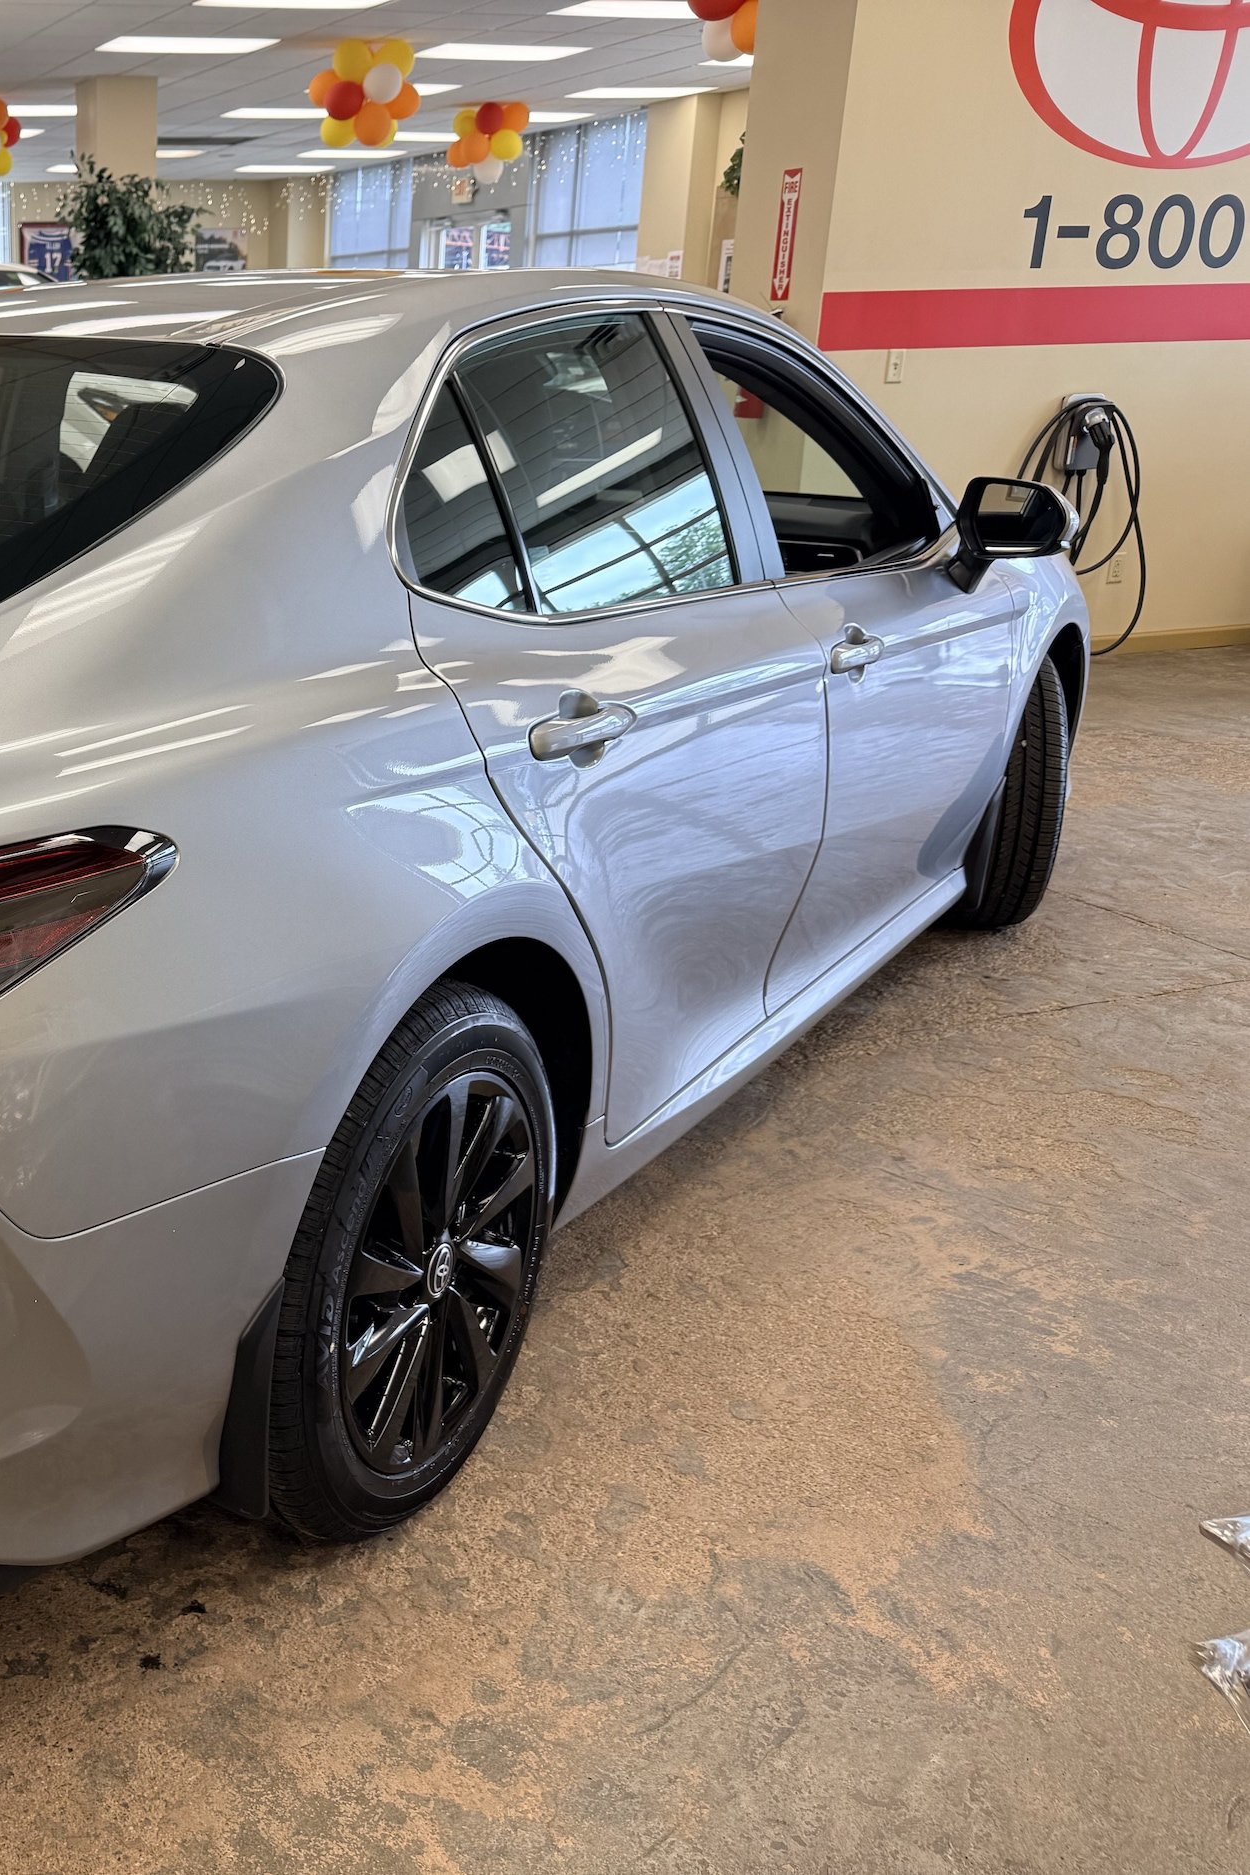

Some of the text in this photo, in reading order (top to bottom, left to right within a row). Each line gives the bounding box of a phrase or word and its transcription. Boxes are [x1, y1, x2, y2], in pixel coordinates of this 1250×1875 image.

[784, 181, 798, 194] FIRE
[777, 198, 792, 290] EXTINGUISHER
[1023, 193, 1246, 269] 1-800
[44, 252, 62, 273] 17
